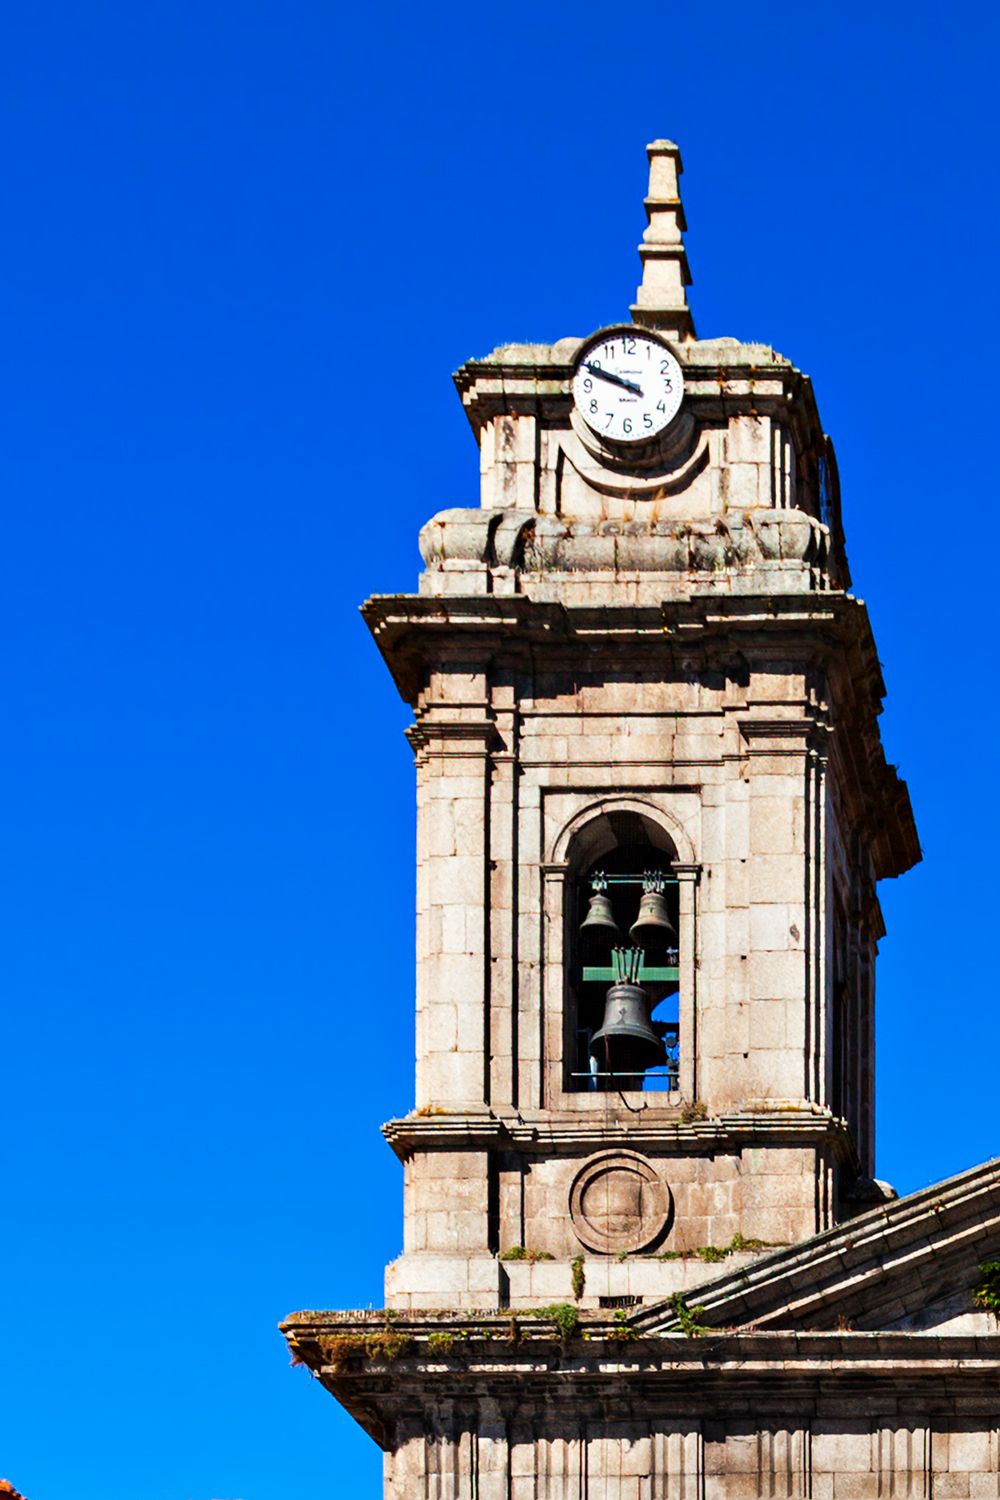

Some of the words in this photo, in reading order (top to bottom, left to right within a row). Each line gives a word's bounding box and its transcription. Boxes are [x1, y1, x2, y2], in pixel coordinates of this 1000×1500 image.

[604, 345, 615, 360] 11
[622, 338, 637, 355] 12
[646, 345, 651, 360] 1
[660, 360, 669, 375] 2
[583, 379, 593, 394] 9
[664, 379, 673, 394] 3
[589, 399, 598, 414] 8
[656, 400, 666, 414] 4
[605, 413, 614, 429] 7
[623, 418, 632, 434] 6
[643, 413, 653, 429] 5
